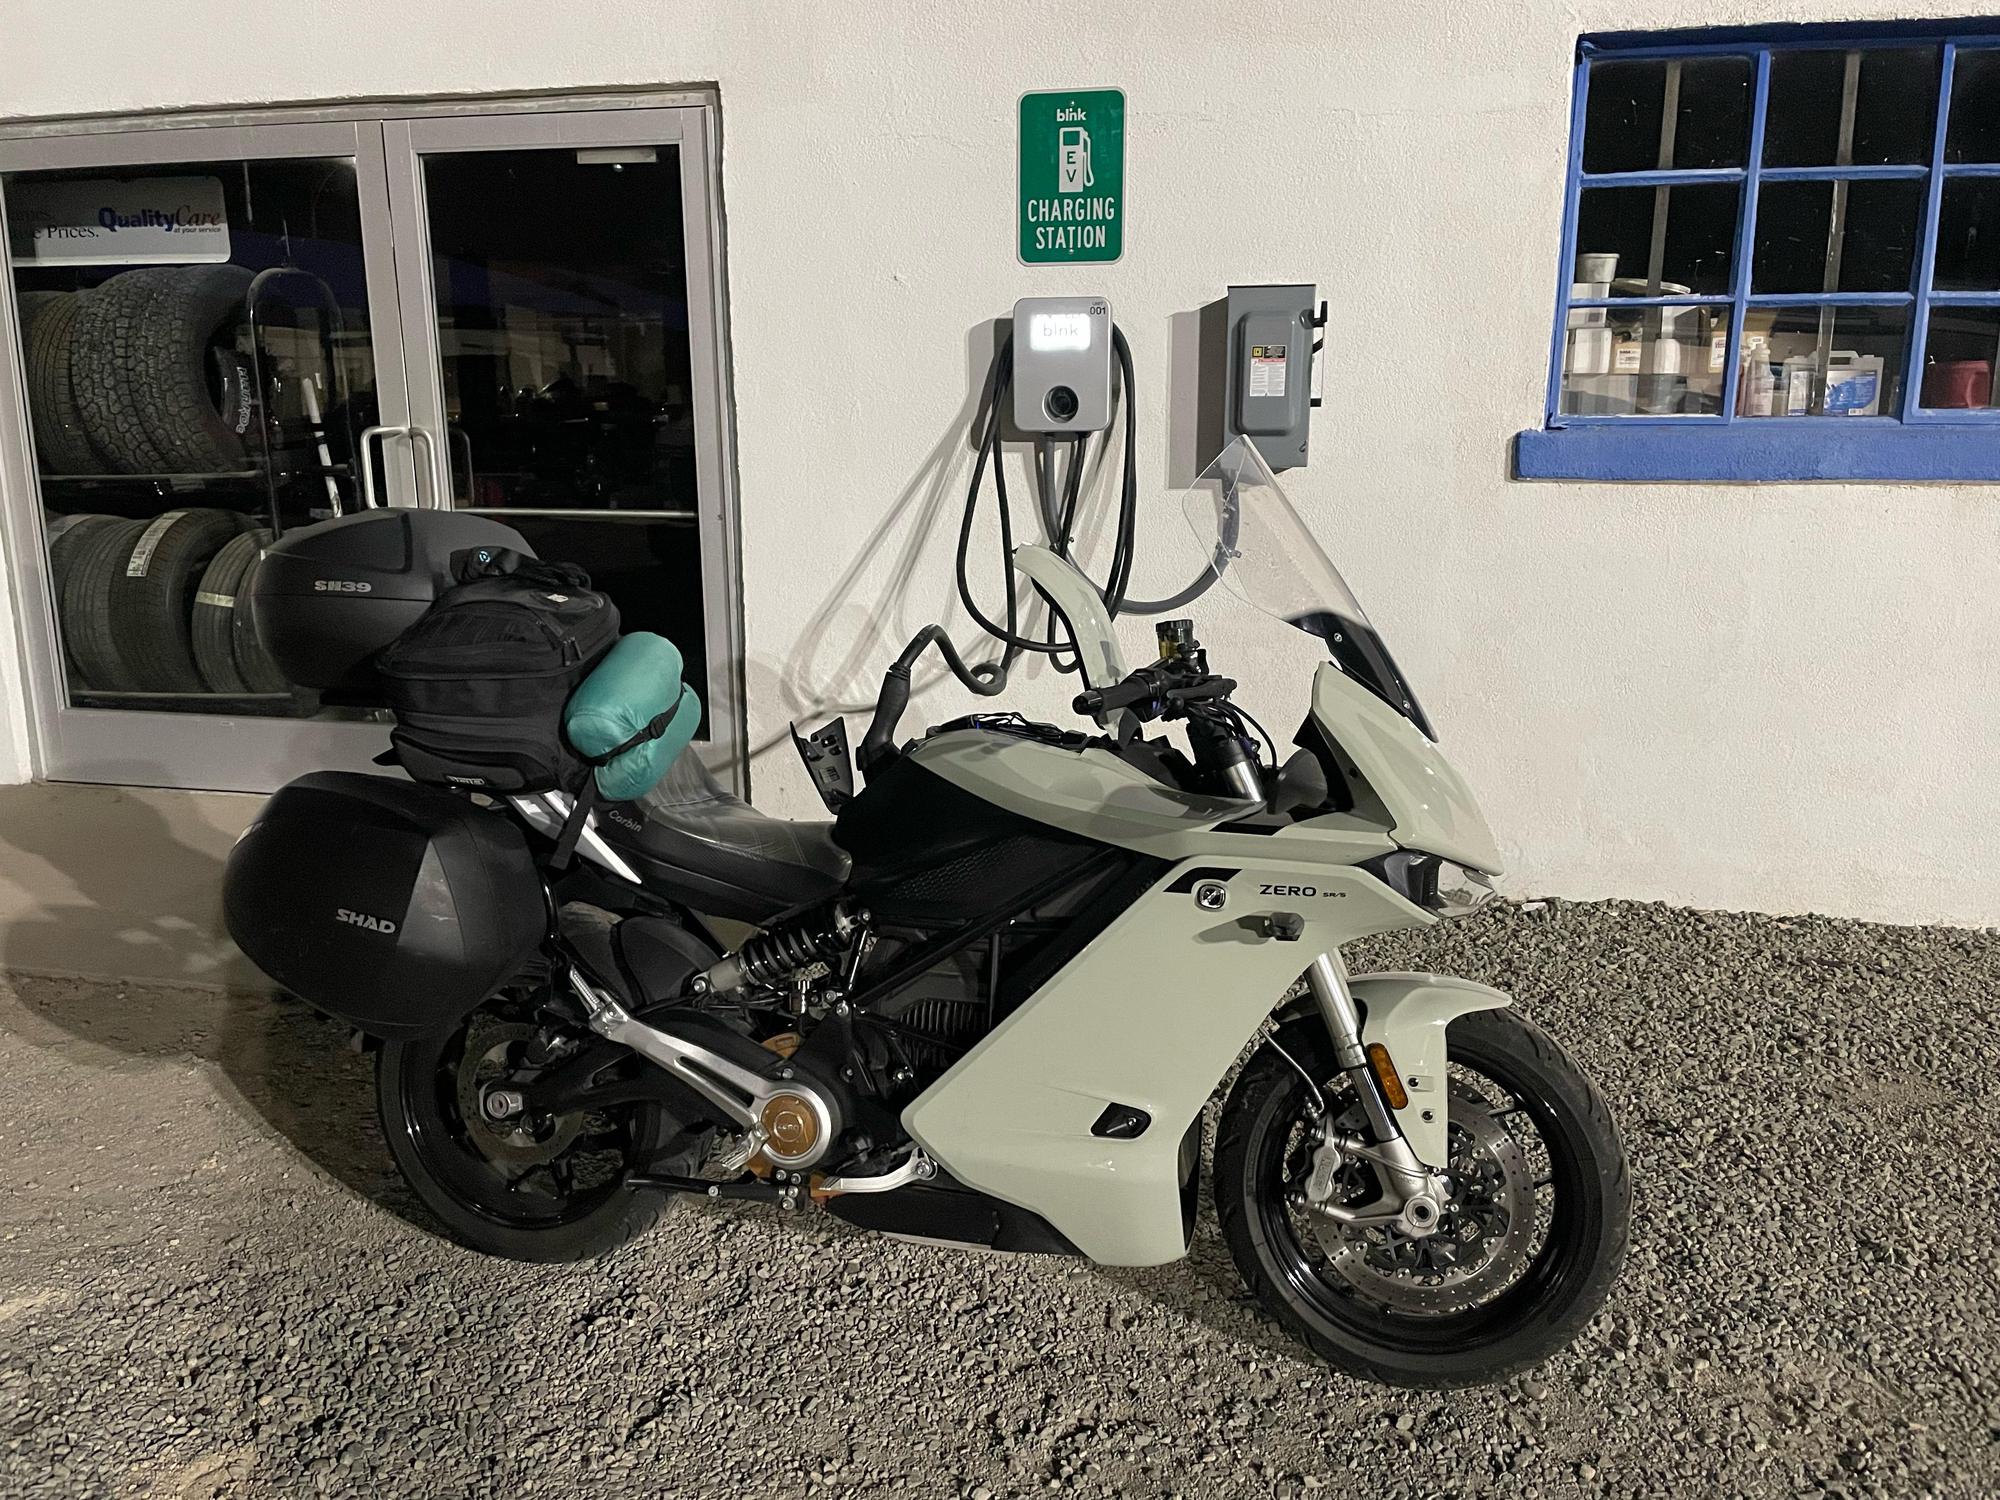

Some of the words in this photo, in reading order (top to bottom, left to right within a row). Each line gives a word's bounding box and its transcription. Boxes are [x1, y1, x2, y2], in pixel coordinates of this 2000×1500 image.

[1056, 107, 1087, 122] blink
[1027, 197, 1115, 222] CHARGING
[47, 224, 99, 239] Prices.
[1035, 225, 1106, 249] STATION
[1089, 306, 1106, 315] 001
[314, 580, 372, 593] SH39
[608, 809, 642, 832] Corbin
[1259, 884, 1317, 897] ZERO
[335, 908, 396, 934] SHAD
